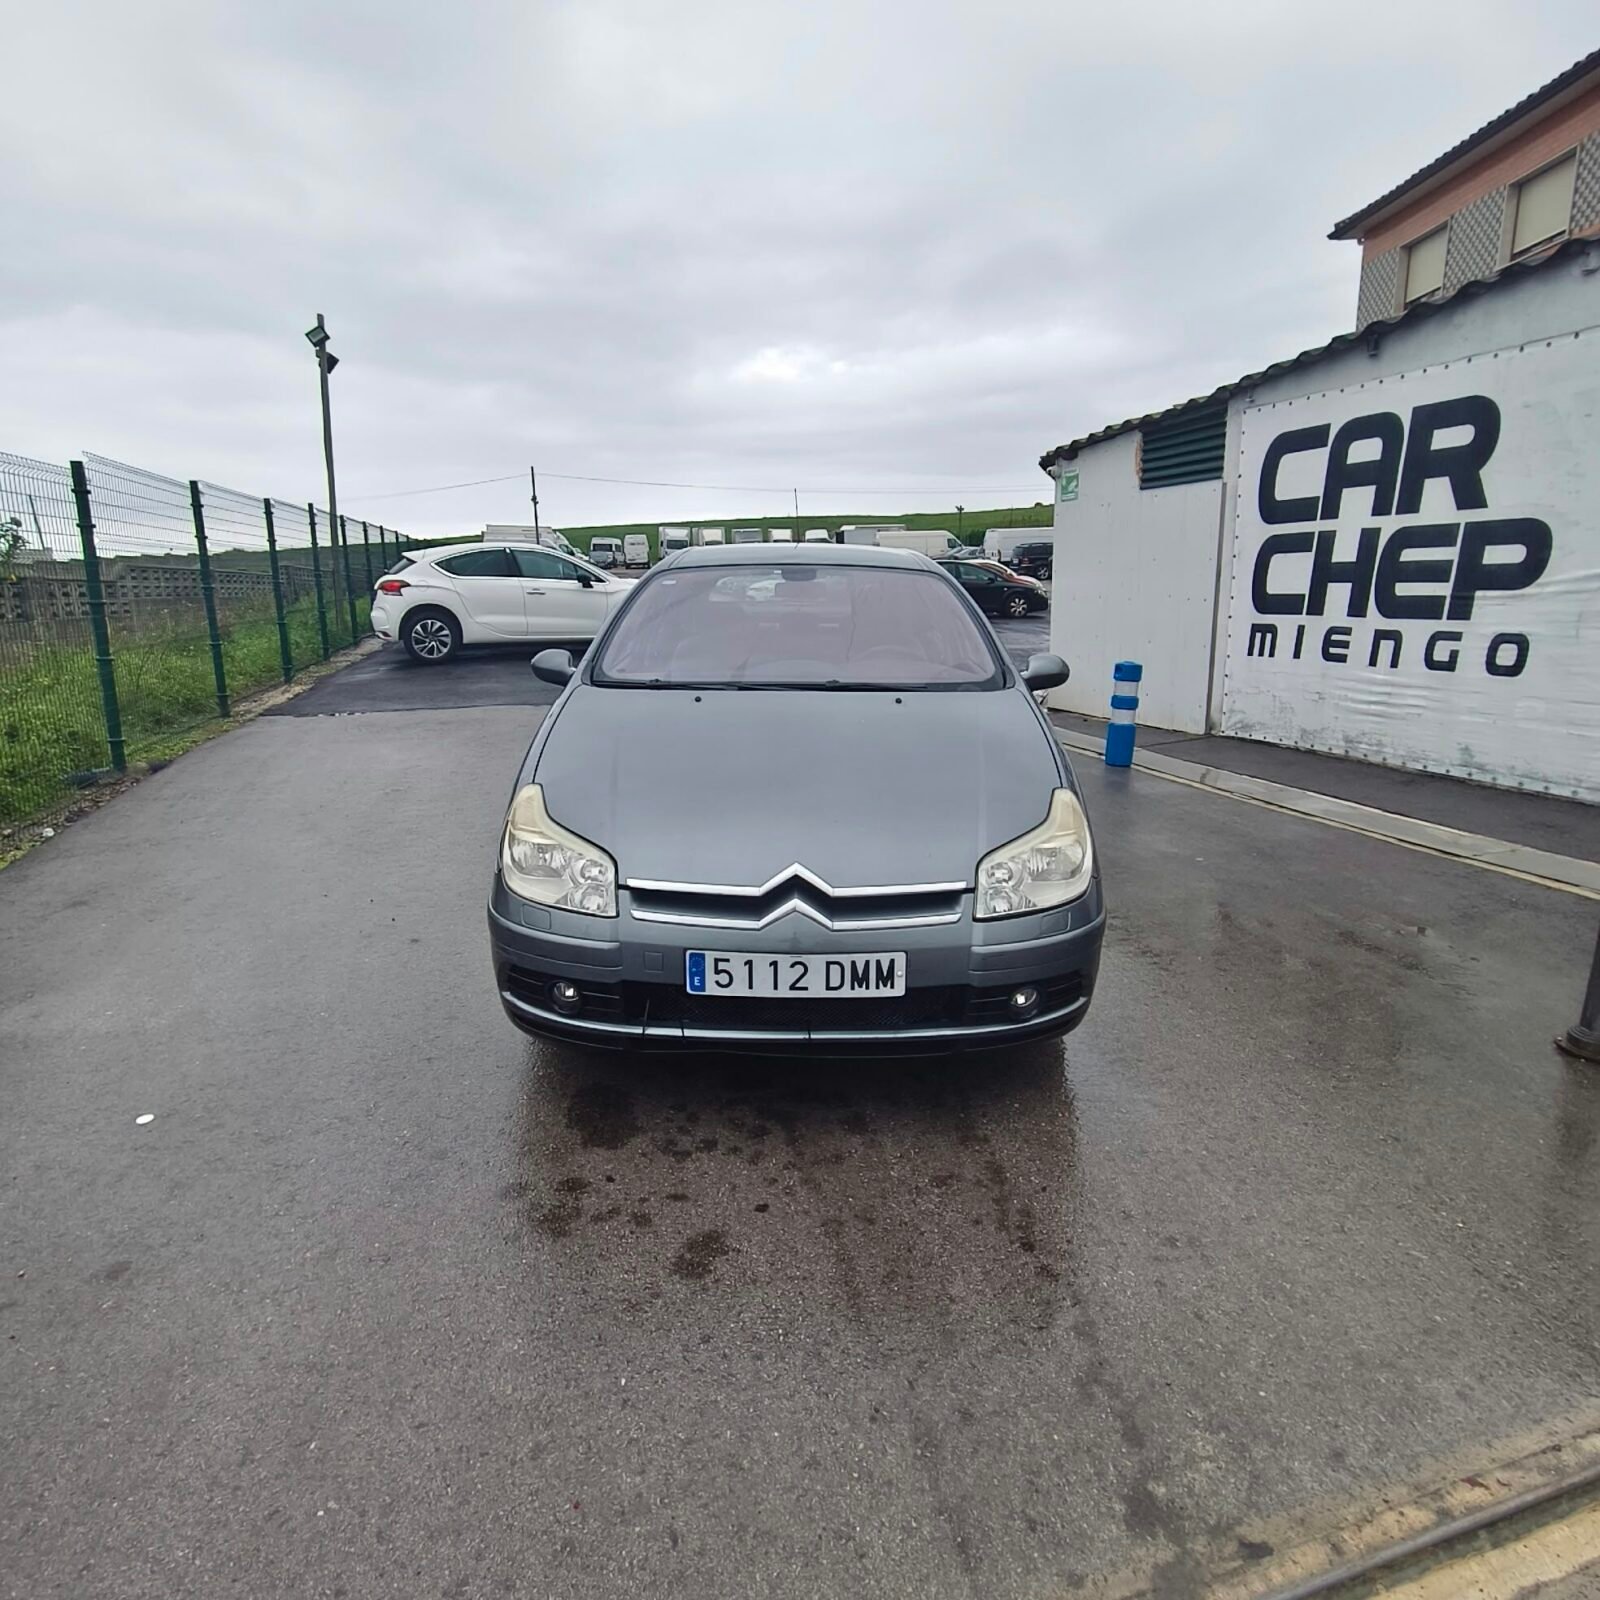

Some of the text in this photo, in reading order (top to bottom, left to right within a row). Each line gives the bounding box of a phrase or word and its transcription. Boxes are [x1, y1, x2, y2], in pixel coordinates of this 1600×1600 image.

[1258, 395, 1501, 525] CAR
[1252, 517, 1553, 620] CHEP
[1247, 623, 1530, 677] MIENGO
[694, 976, 701, 986] E
[713, 957, 895, 991] 5112 DMM
